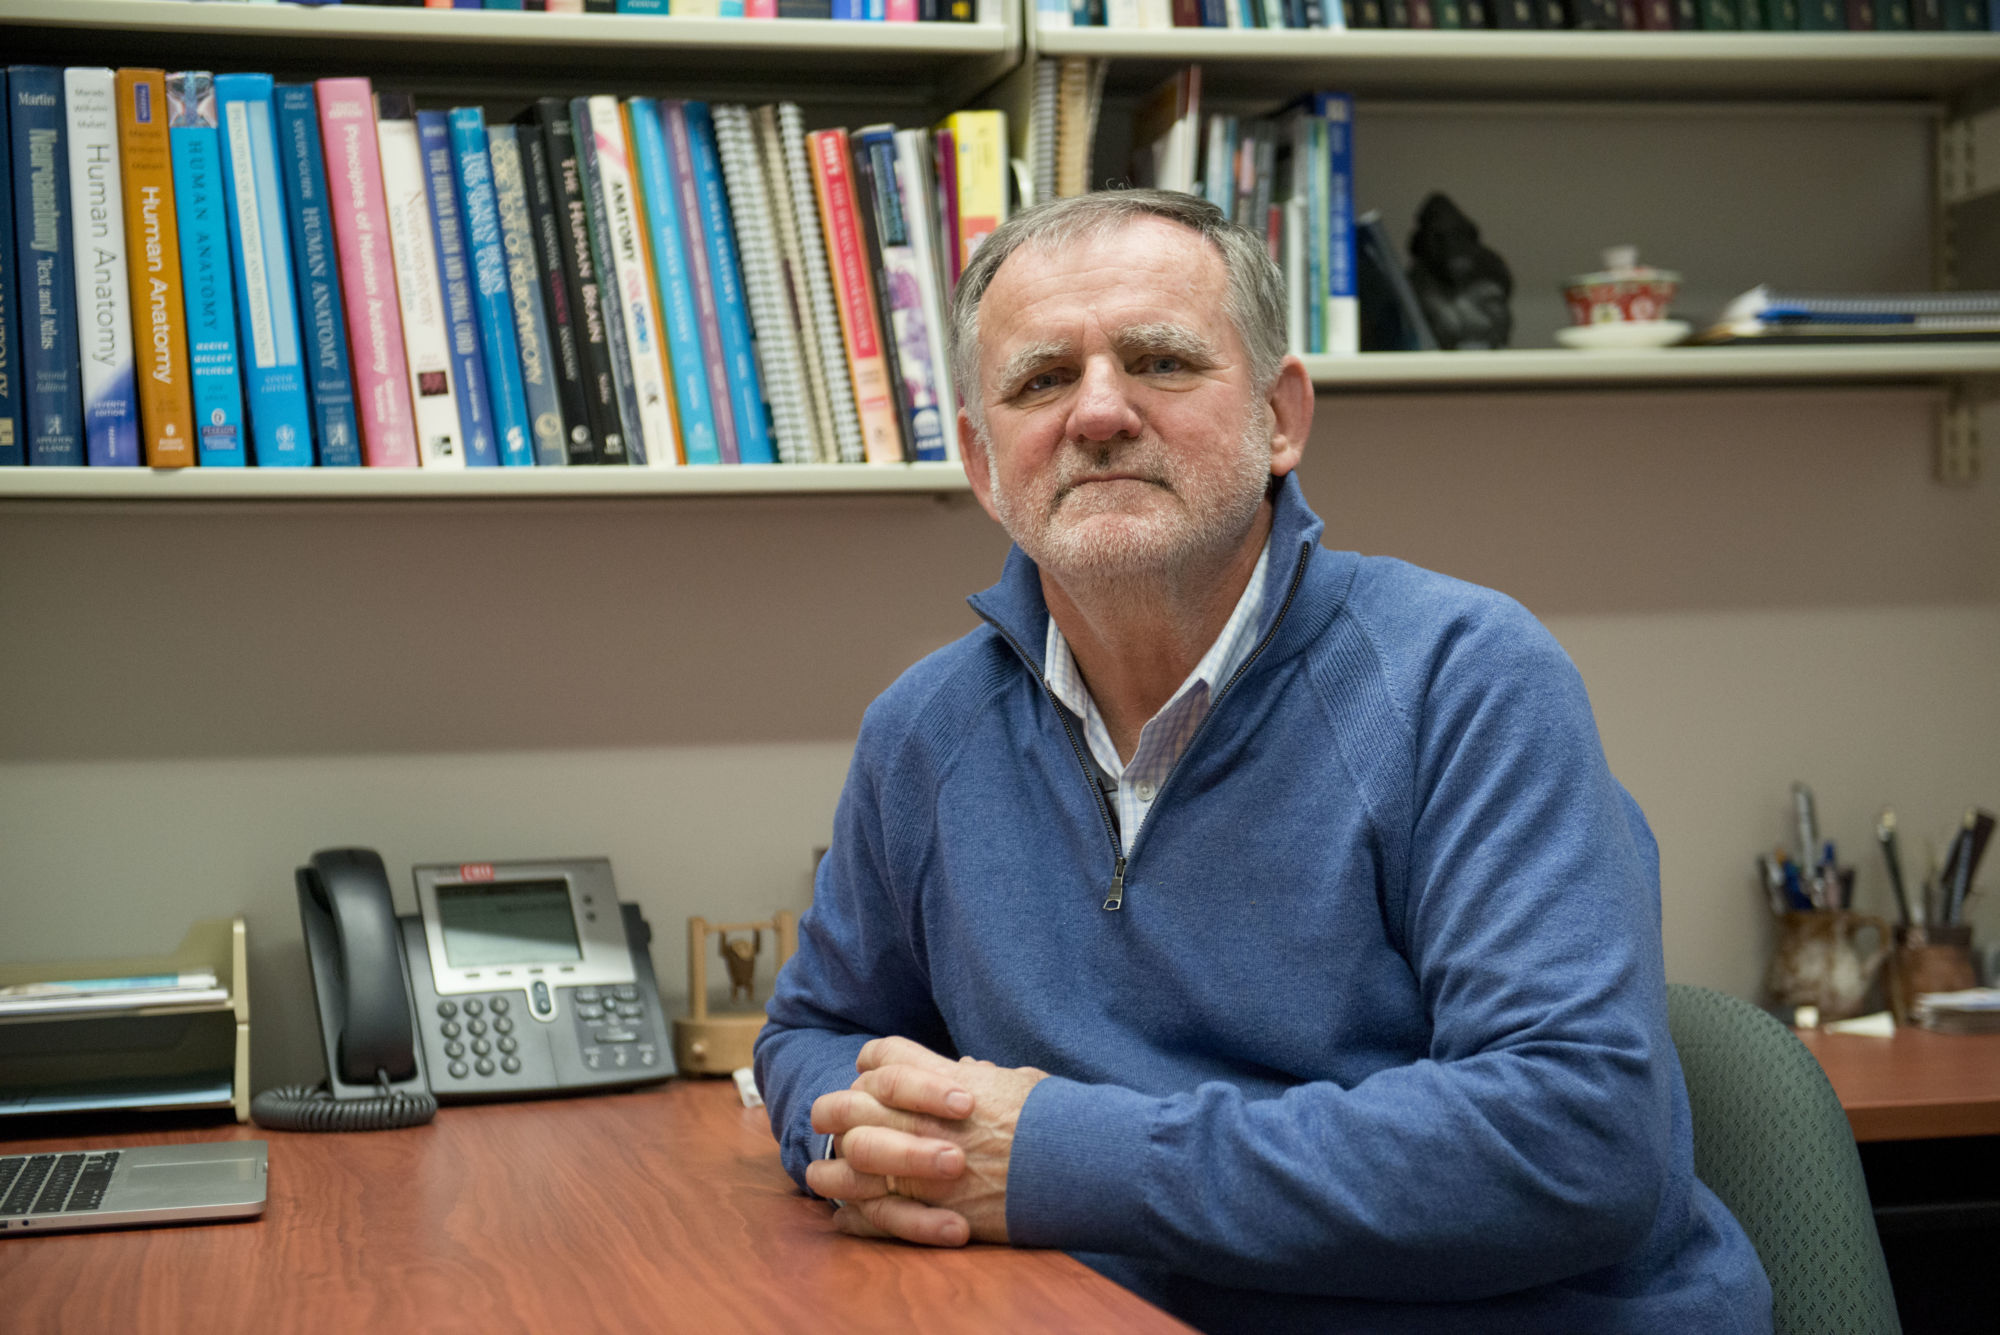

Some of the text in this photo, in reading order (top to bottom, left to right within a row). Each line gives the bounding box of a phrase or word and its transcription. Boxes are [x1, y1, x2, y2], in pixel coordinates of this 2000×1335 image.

[18, 92, 56, 106] Martin
[344, 124, 366, 208] Principles
[429, 149, 448, 173] THE
[490, 138, 511, 191] CORE
[561, 158, 577, 195] THE
[355, 211, 372, 231] of
[432, 175, 455, 216] HUMAN
[497, 191, 518, 231] TEXT
[612, 181, 635, 261] ANATOMY
[29, 129, 60, 349] Neuroanatomy Text and Atlas
[87, 144, 117, 367] Human Anatomy
[189, 141, 217, 330] HUMAN ANATOMY
[302, 207, 327, 277] HUMAN
[439, 218, 460, 254] BRAIN
[503, 231, 523, 258] OF
[568, 201, 591, 278] HUMAN
[141, 186, 172, 384] Human Anatomy
[359, 233, 378, 296] Human
[444, 256, 464, 280] AND
[312, 281, 338, 370] ANATOMY
[448, 280, 470, 322] SPINAL
[582, 283, 602, 343] BRAIN
[368, 298, 388, 375] Anatomy
[454, 322, 475, 355] CORD
[559, 325, 577, 381] ANATOMY
